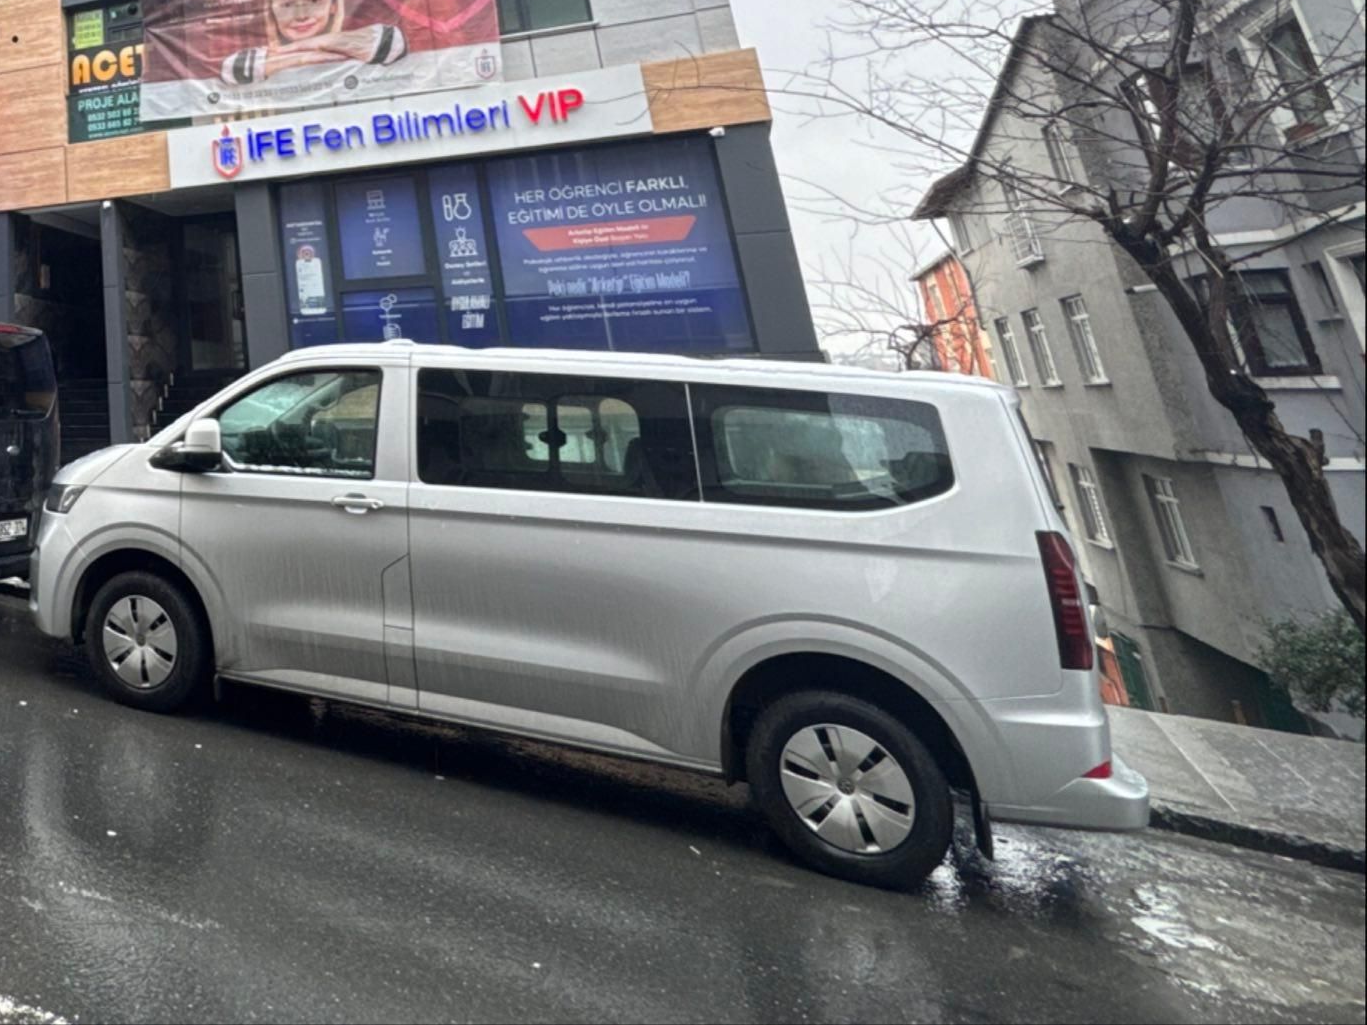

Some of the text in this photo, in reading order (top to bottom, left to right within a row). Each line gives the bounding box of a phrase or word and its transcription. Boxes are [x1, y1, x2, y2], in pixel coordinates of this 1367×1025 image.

[78, 95, 114, 112] PROJE
[247, 87, 585, 161] İFE Fen Bilimleri VIP
[514, 189, 545, 204] HER
[567, 204, 588, 220] DE
